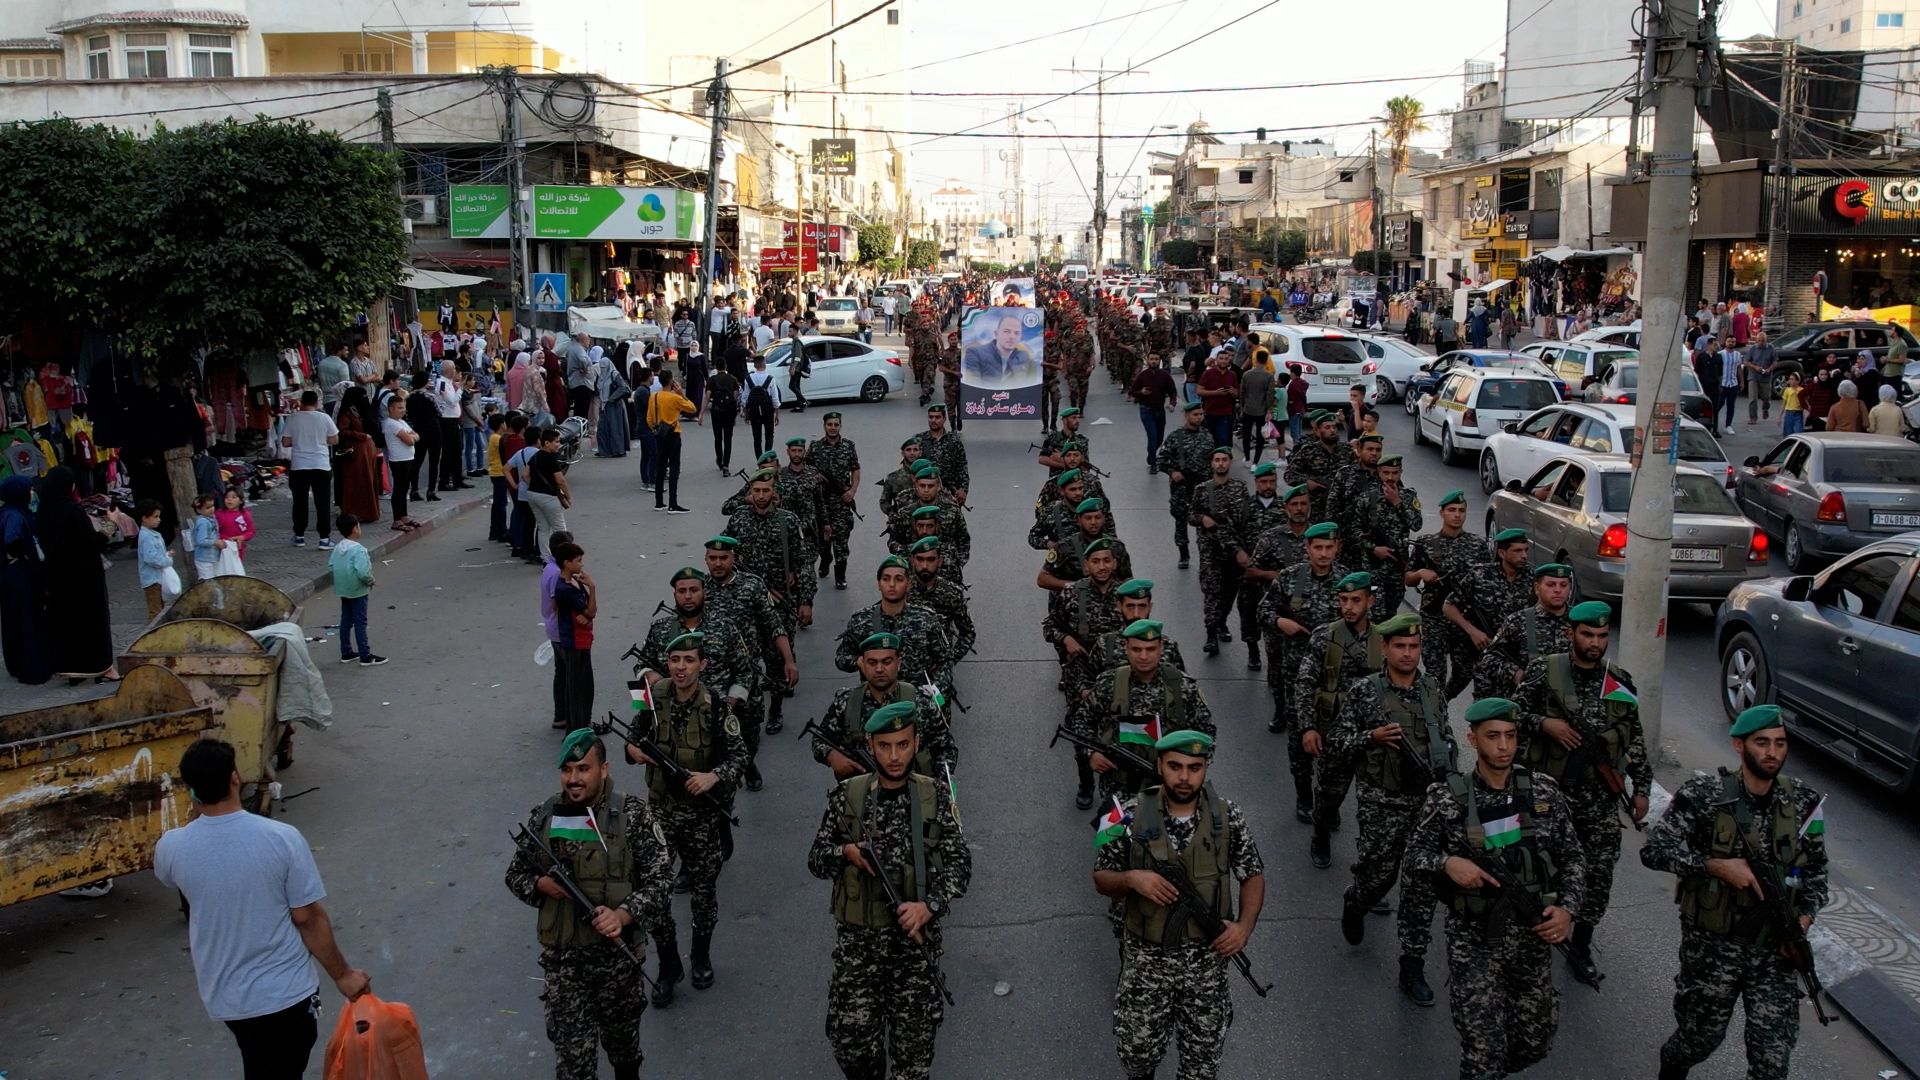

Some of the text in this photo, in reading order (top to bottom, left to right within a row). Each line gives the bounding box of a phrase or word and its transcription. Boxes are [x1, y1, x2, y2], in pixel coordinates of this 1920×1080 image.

[454, 192, 497, 203] شركة حرز الله
[539, 192, 590, 203] شركة حرز الله
[455, 205, 488, 213] للاتصالات
[539, 206, 578, 215] للاتصالات
[640, 225, 664, 235] جوال
